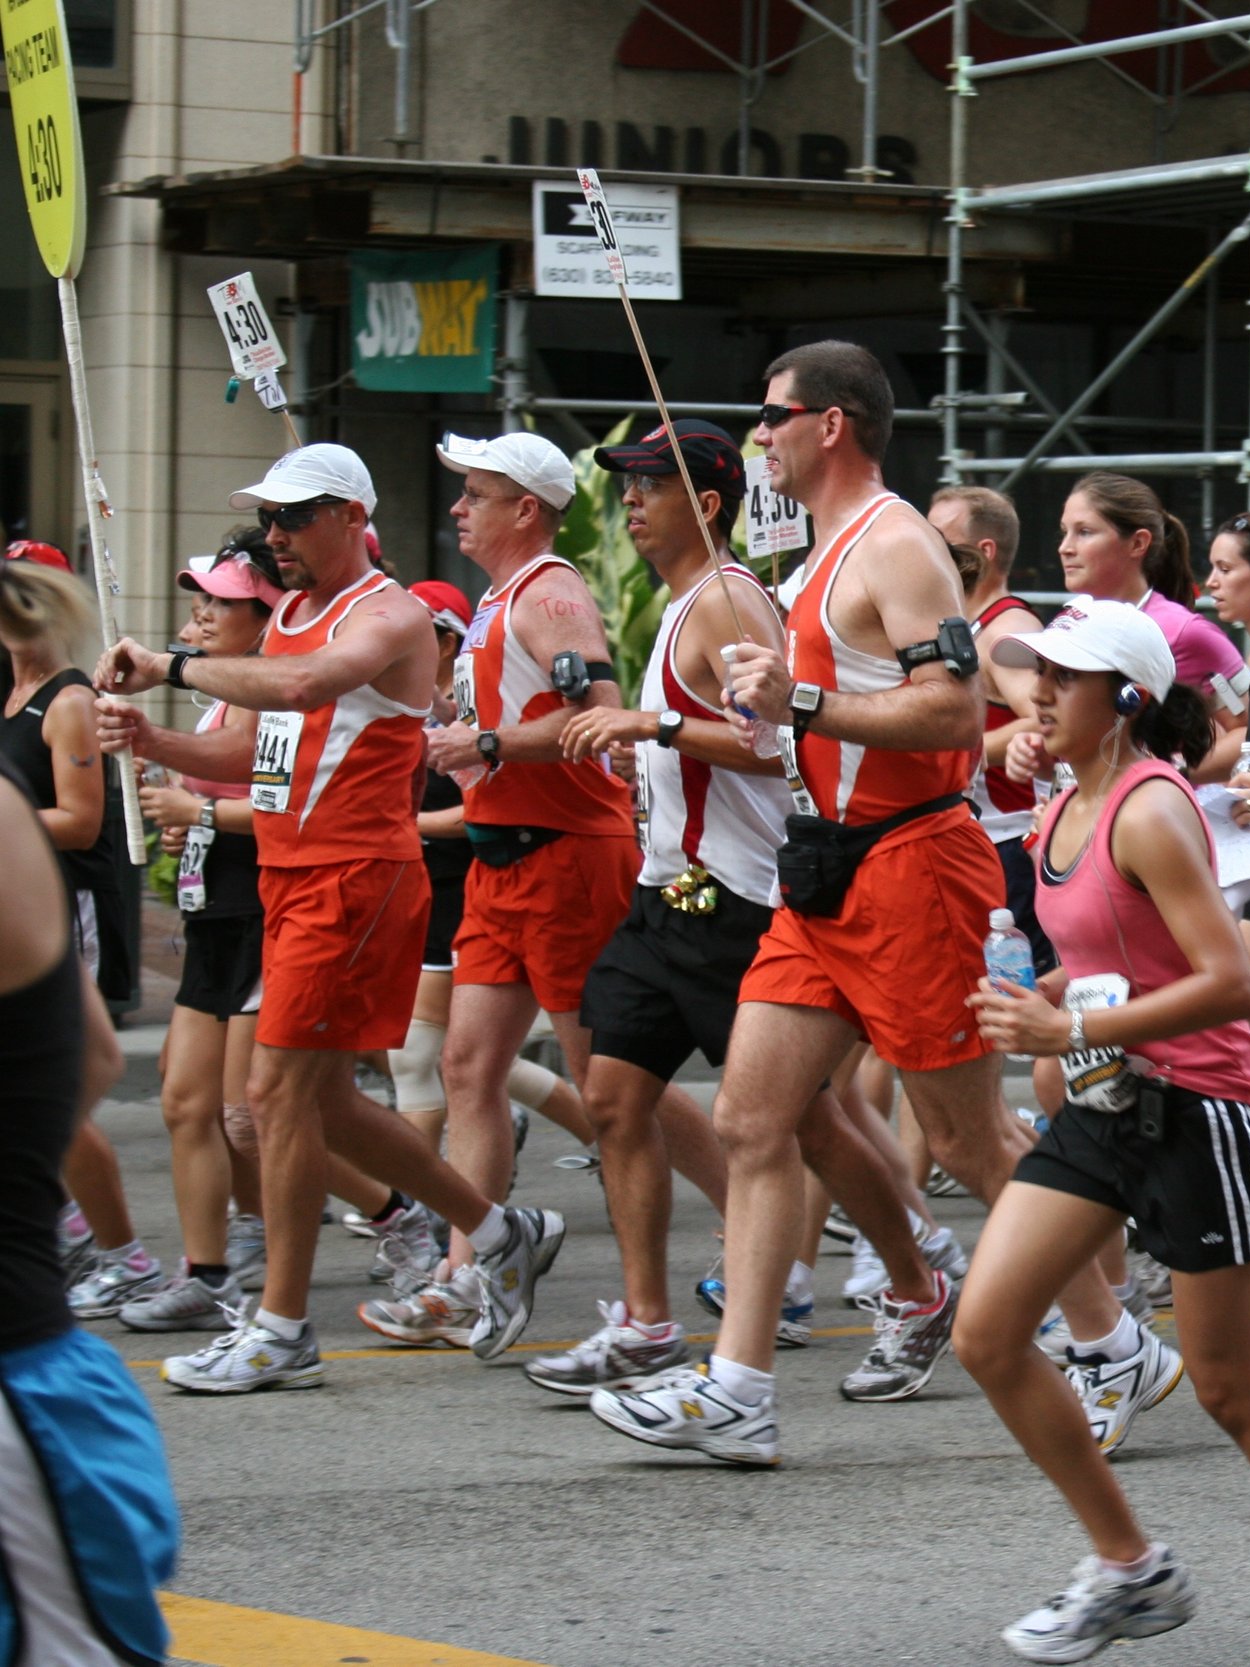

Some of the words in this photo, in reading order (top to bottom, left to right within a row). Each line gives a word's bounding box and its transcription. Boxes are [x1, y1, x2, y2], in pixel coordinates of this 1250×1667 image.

[32, 26, 60, 74] TEAM
[28, 114, 63, 203] 4:30
[482, 115, 918, 185] JUNIORS
[586, 210, 668, 223] SFWAY
[556, 242, 660, 257] SCAFFDING
[593, 268, 675, 286] 83-5840
[223, 300, 269, 350] 4:30
[355, 277, 487, 358] SUBWAY
[750, 484, 798, 527] 4:30
